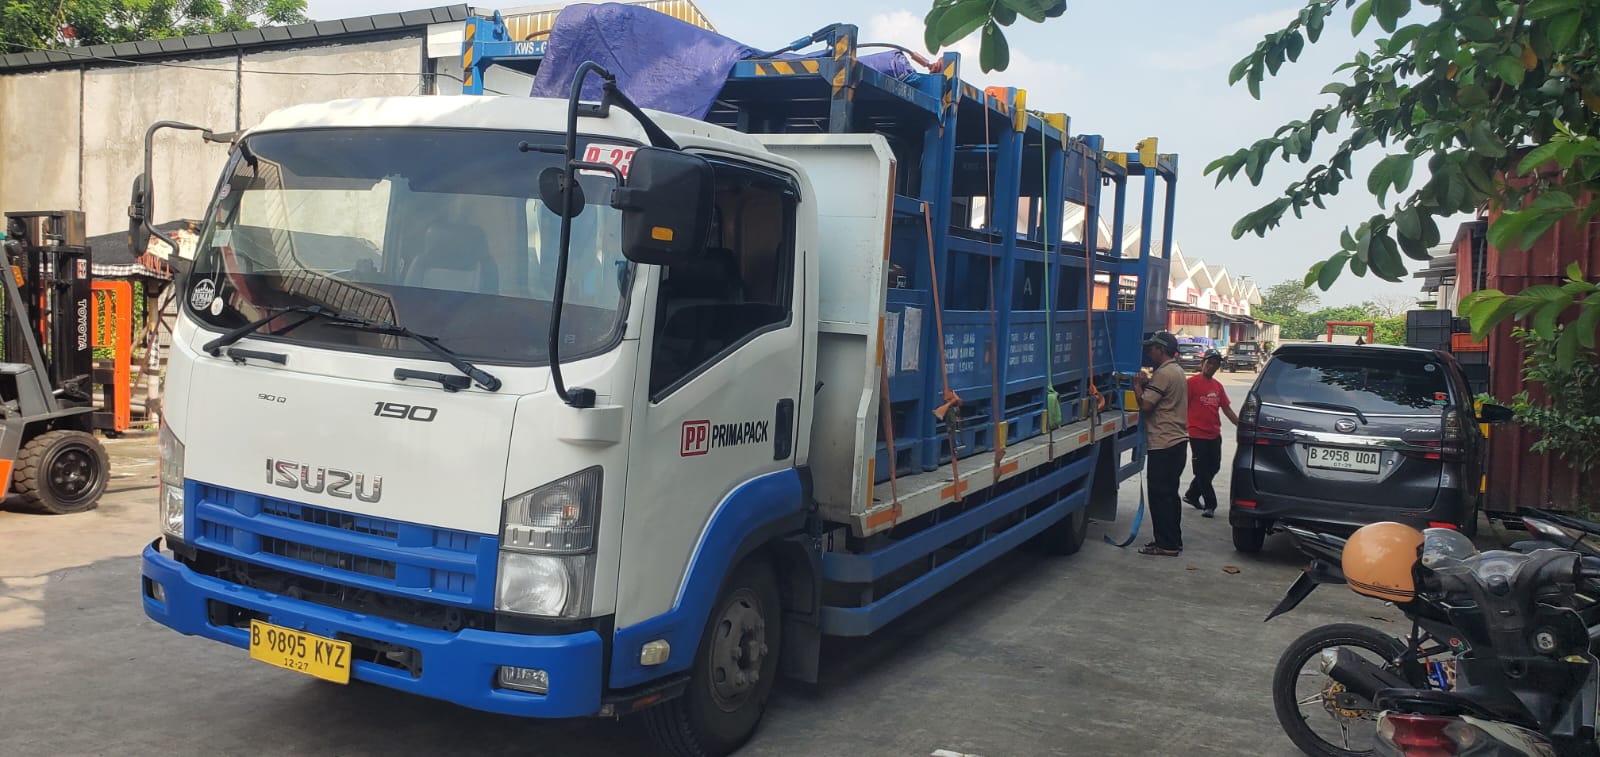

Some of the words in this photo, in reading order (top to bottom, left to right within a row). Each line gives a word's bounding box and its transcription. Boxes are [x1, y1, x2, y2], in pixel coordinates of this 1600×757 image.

[1023, 276, 1033, 296] A
[77, 298, 87, 351] TOYOTA
[258, 393, 276, 402] 90
[373, 401, 438, 423] 190
[685, 425, 707, 451] PP
[711, 419, 769, 449] PRIMAPACK
[1310, 448, 1318, 460] B
[1321, 449, 1350, 462] 2958
[1355, 452, 1377, 465] UOA
[265, 456, 383, 504] ISUZU
[252, 624, 261, 646] B
[267, 629, 307, 659] 9895
[314, 639, 346, 669] KYZ
